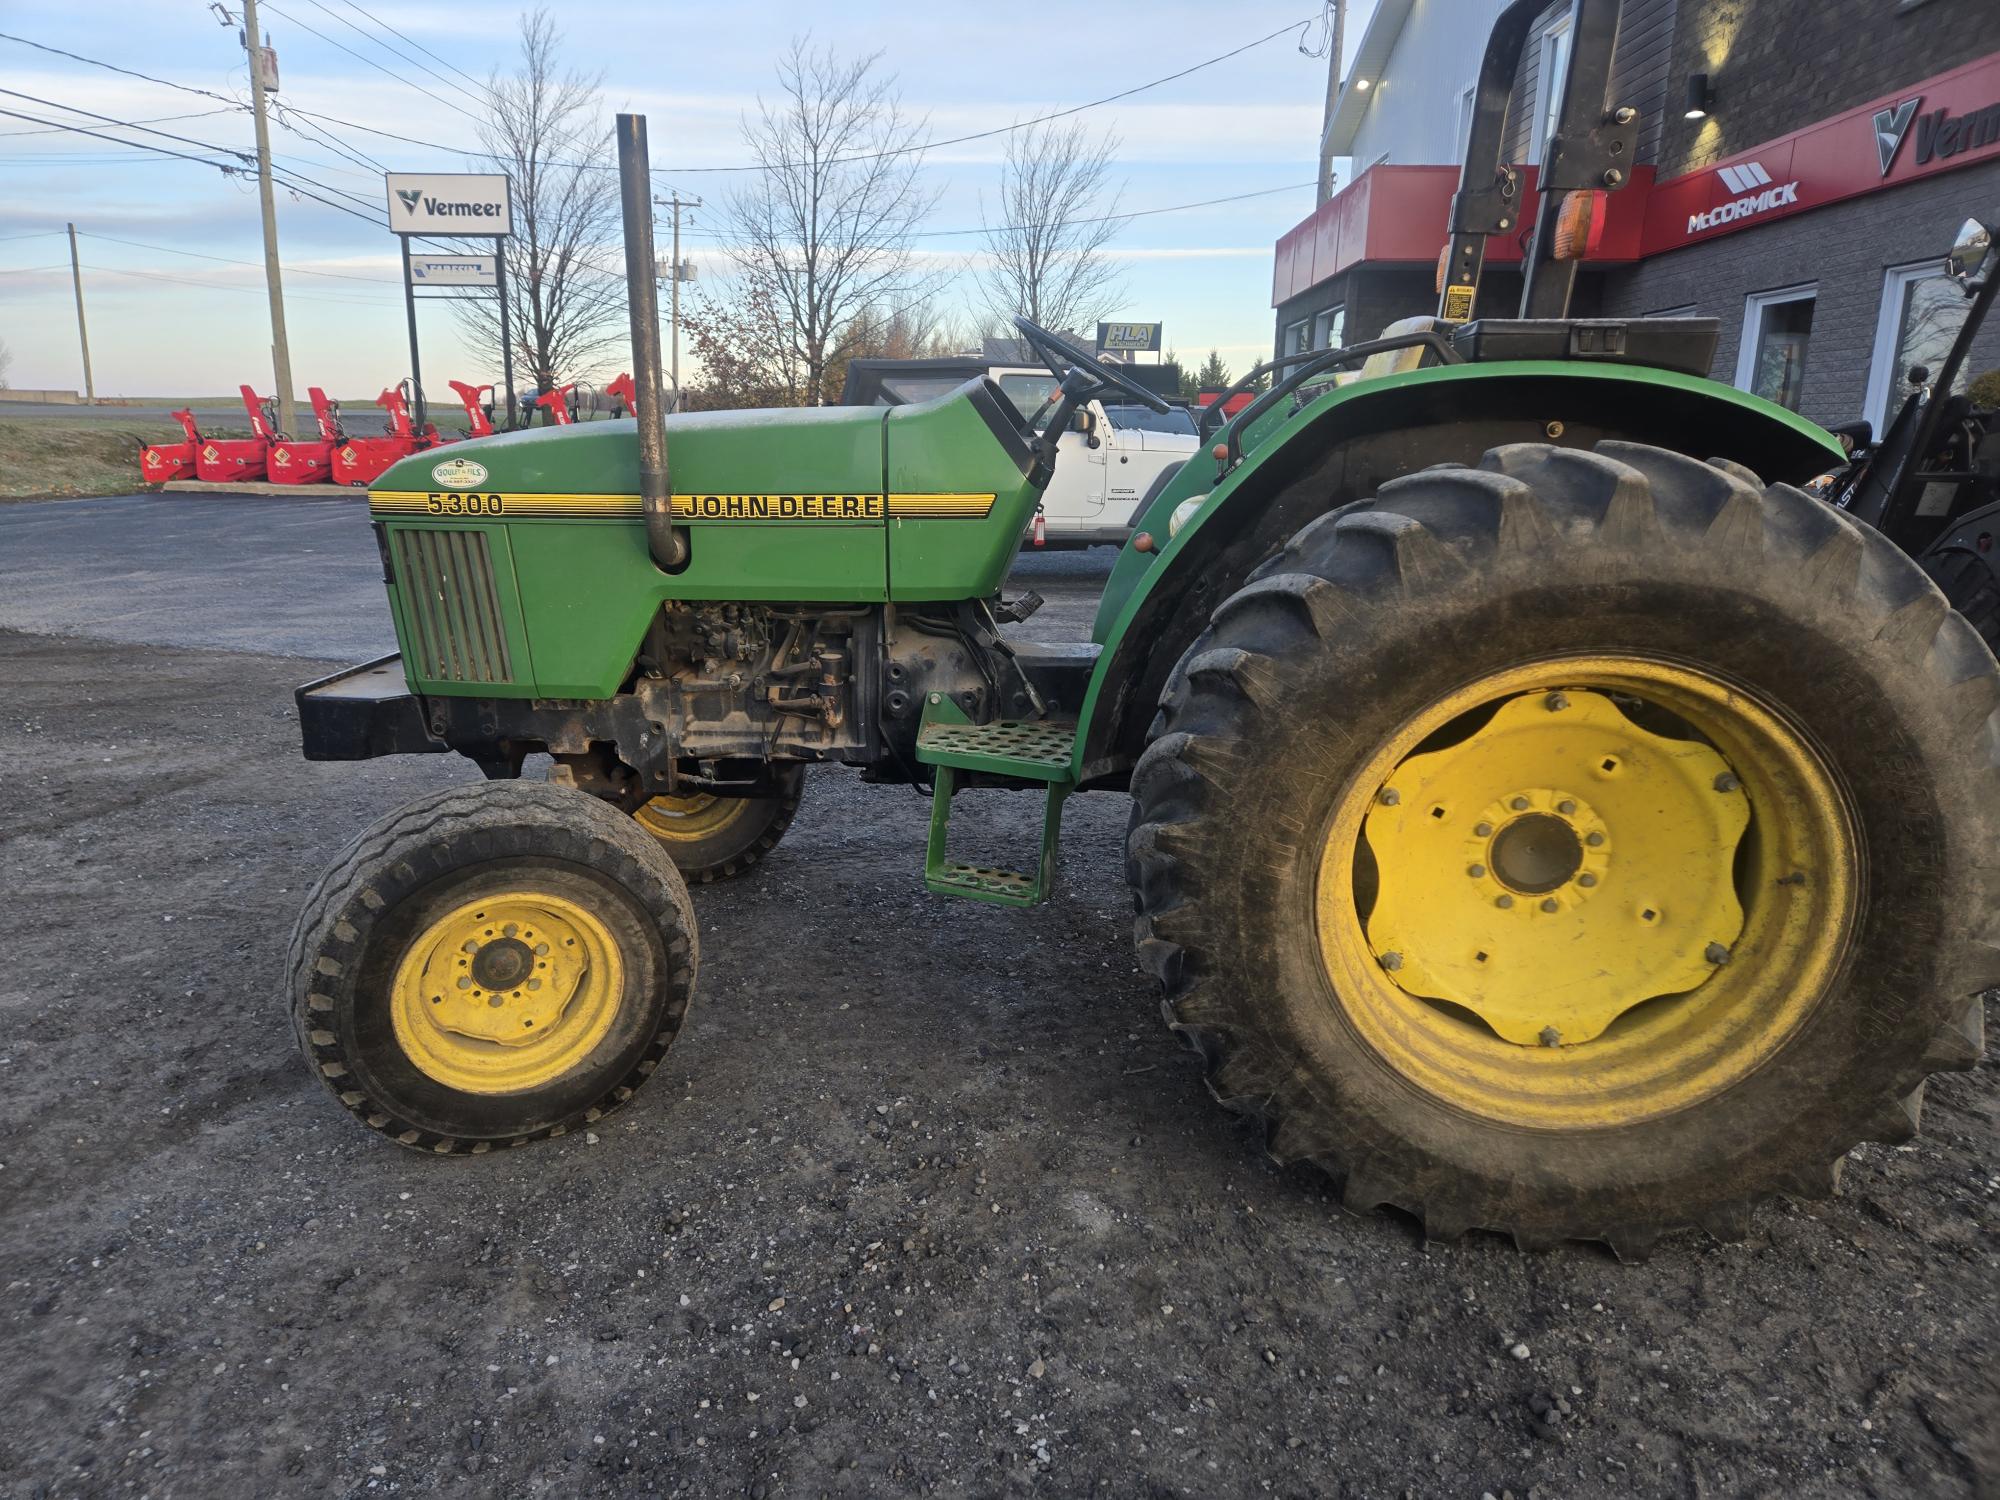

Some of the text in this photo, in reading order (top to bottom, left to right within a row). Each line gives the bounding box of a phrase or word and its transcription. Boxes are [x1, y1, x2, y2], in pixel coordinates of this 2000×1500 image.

[424, 197, 501, 216] Vermeer
[1110, 325, 1149, 341] HLA
[428, 493, 503, 515] 5300
[683, 495, 881, 518] JOHN DEERE
